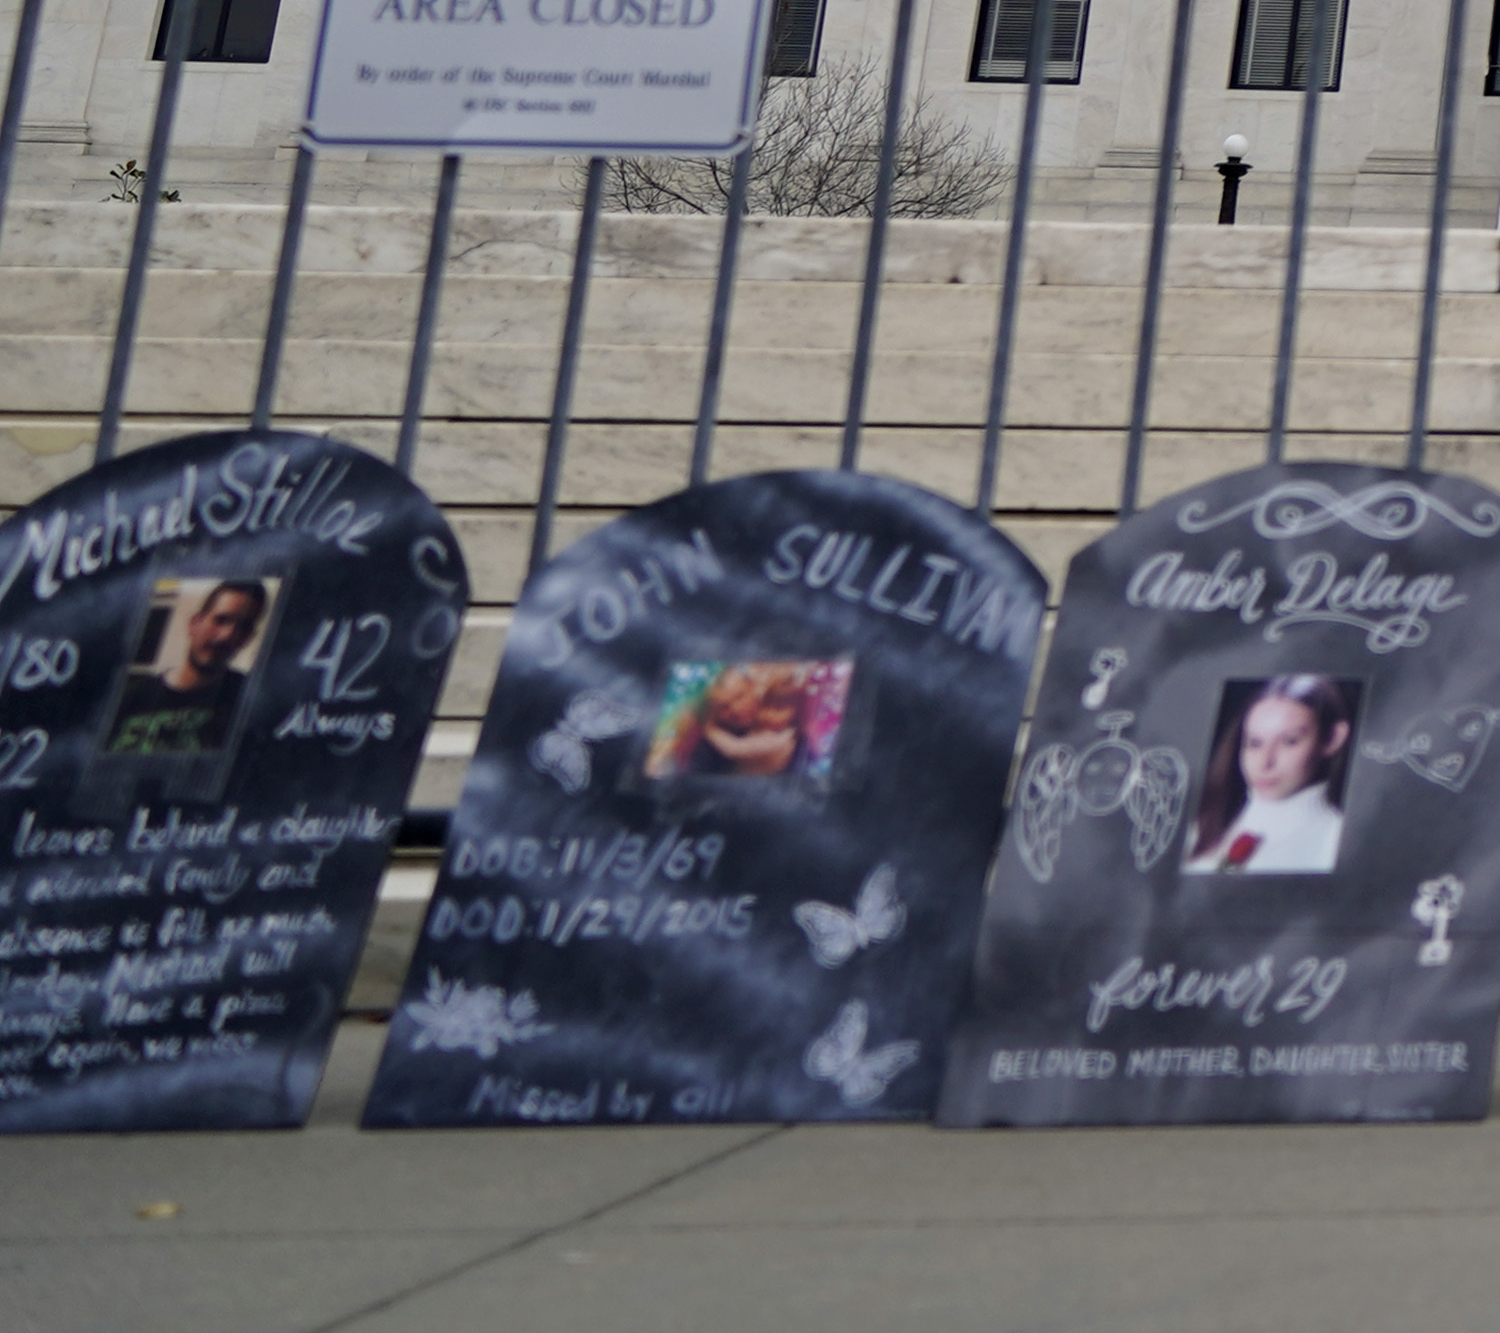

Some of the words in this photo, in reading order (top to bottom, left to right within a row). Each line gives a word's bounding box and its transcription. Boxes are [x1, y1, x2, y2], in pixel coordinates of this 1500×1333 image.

[389, 67, 433, 83] order
[441, 66, 463, 84] of
[504, 67, 577, 87] Supreme
[582, 69, 633, 87] Court
[642, 69, 711, 88] Marshal
[0, 463, 198, 600] Michael
[541, 528, 726, 670] JOHN
[302, 612, 391, 702] 42
[1087, 955, 1275, 1032] forever
[1274, 957, 1349, 1024] 29
[988, 1047, 1117, 1083] BELOVED
